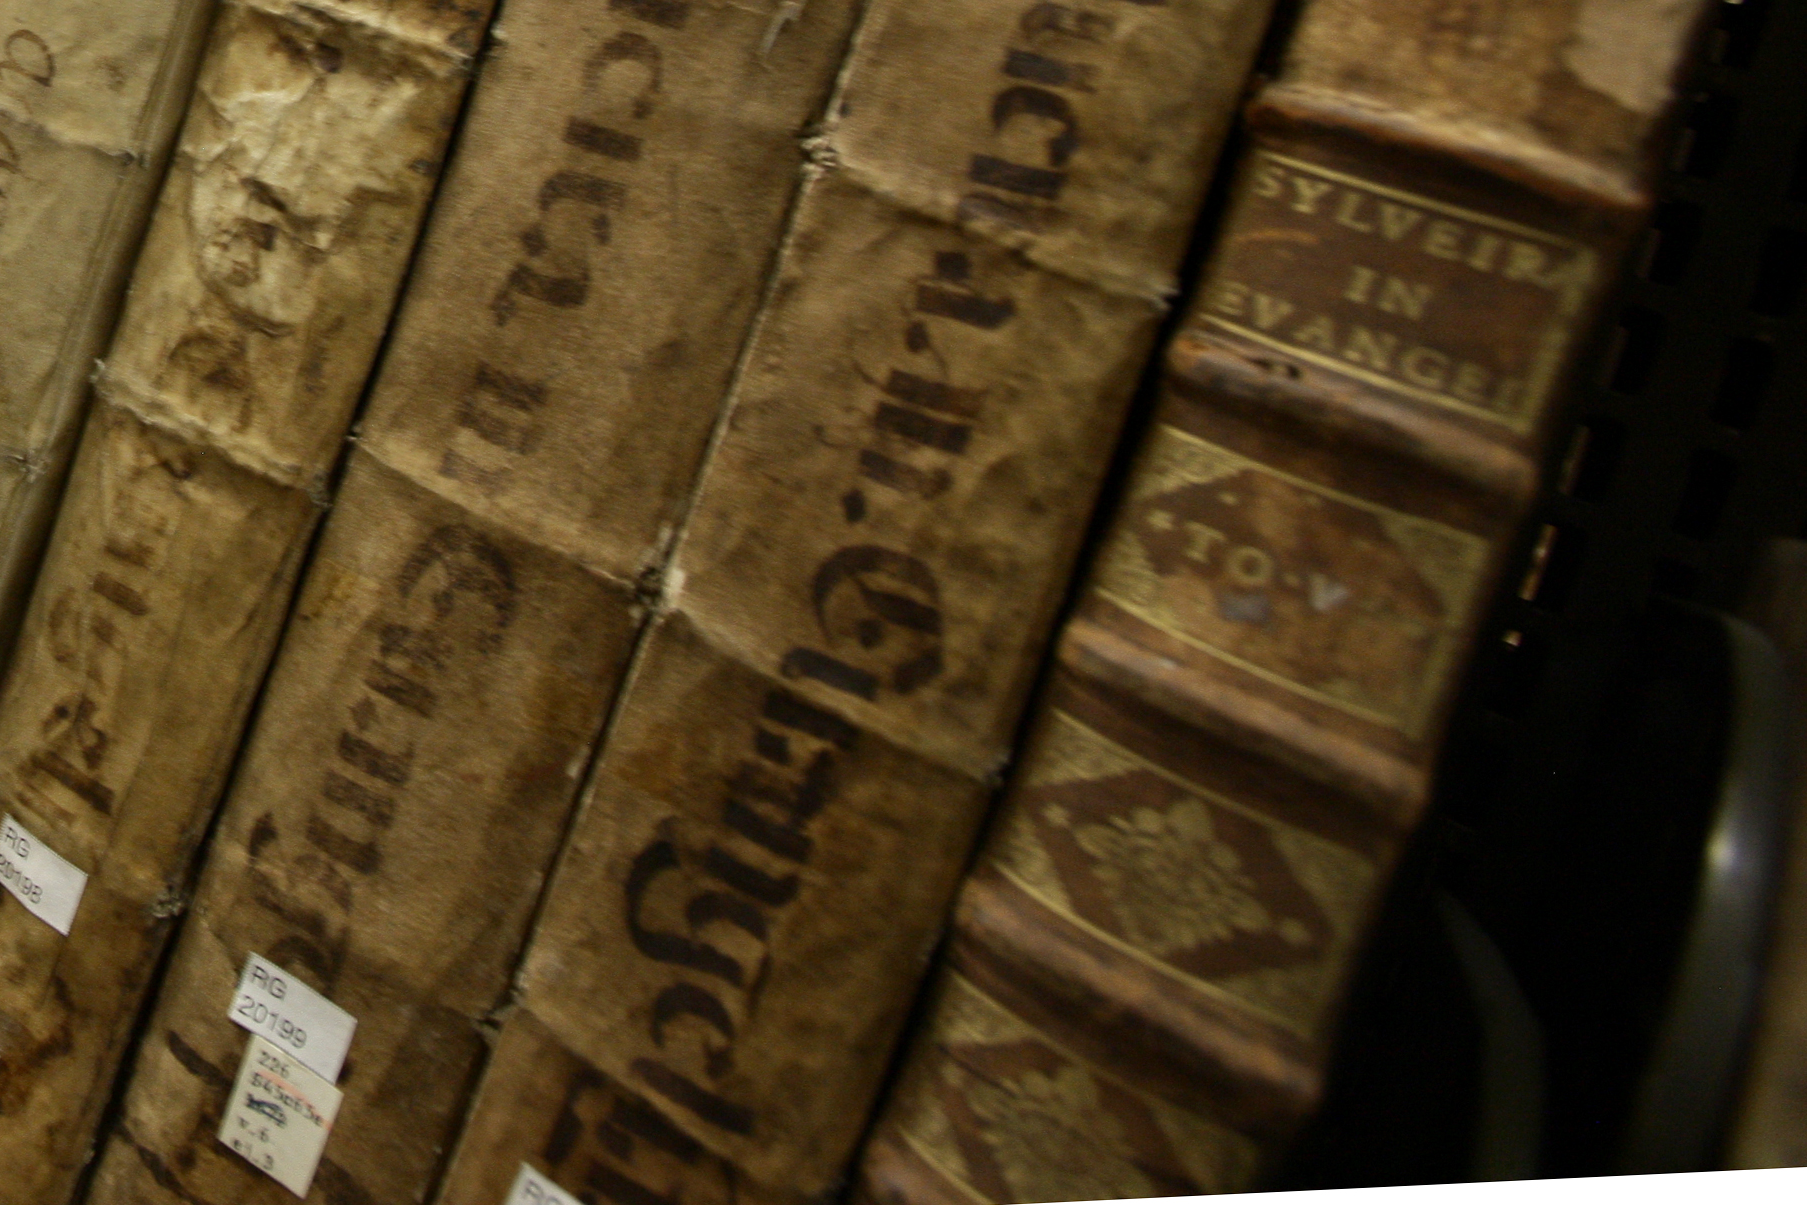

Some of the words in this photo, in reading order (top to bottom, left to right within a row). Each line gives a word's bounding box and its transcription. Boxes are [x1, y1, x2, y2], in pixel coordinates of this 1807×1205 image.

[1343, 265, 1434, 320] IN
[5, 825, 32, 861] RG
[250, 964, 288, 1002] RG
[238, 994, 308, 1050] 20199
[257, 1050, 291, 1078] 226
